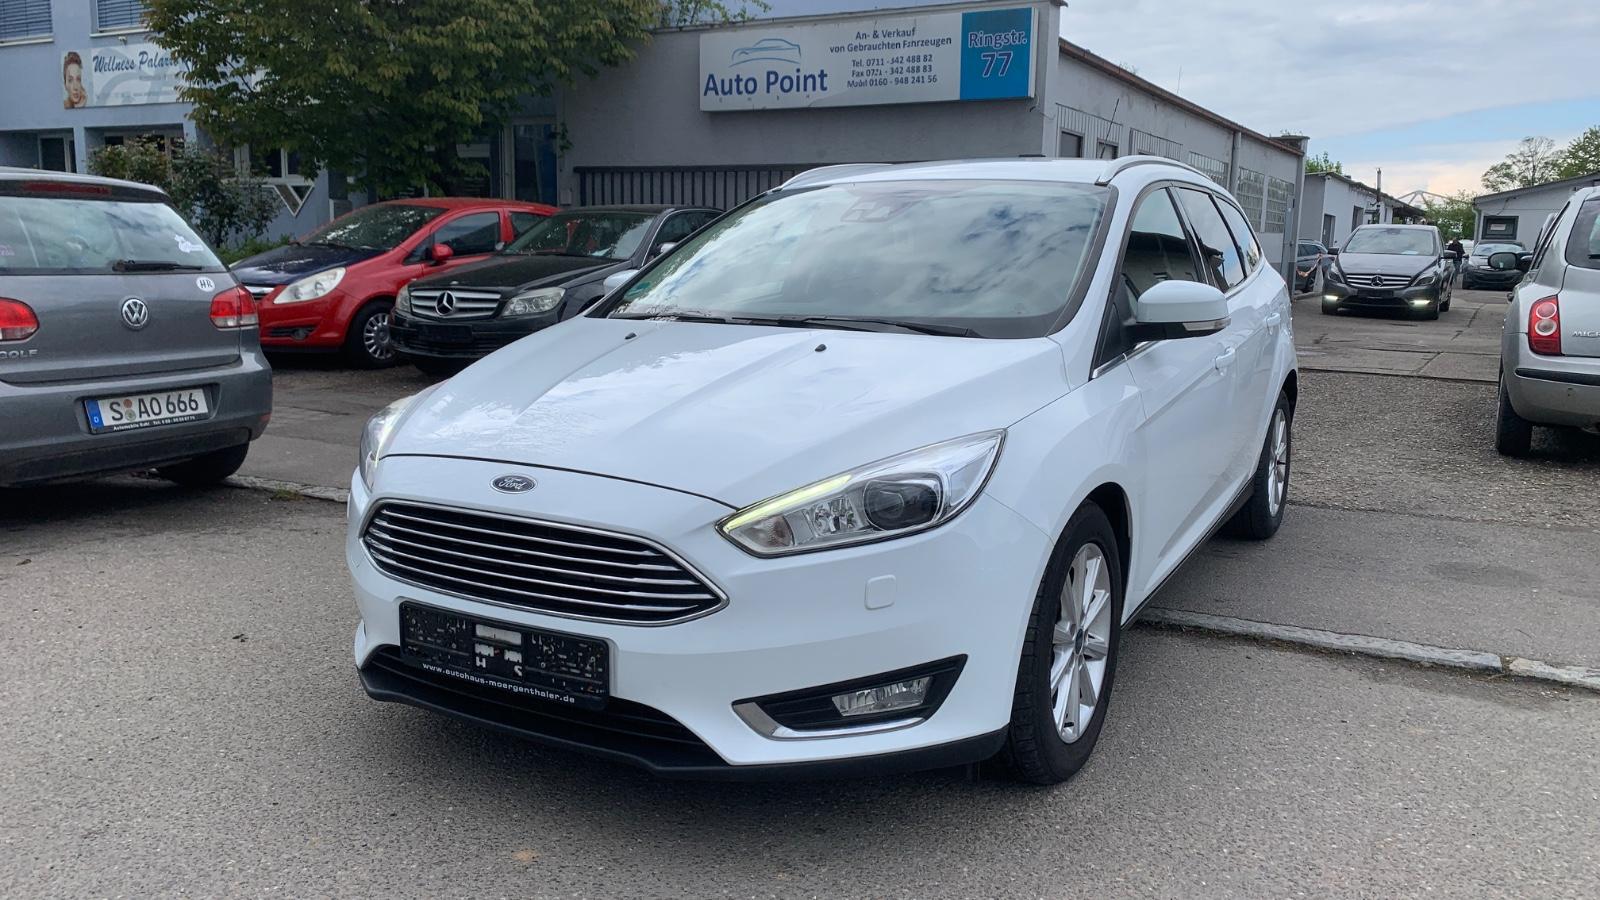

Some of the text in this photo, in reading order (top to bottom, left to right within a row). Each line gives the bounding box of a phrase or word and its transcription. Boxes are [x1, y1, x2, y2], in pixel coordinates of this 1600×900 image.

[855, 27, 916, 40] An- & Verkauf
[968, 29, 1028, 50] Ringstr.
[847, 41, 901, 53] Gebrauchten
[902, 37, 952, 49] Fahrzeugen
[92, 55, 136, 73] Wellness
[851, 59, 864, 68] Tel.
[866, 58, 884, 67] 0711
[890, 57, 904, 65] 342
[906, 55, 920, 64] 488
[922, 54, 933, 62] 82
[981, 51, 1013, 78] 77
[851, 69, 864, 78] Fax
[889, 67, 904, 75] 342
[905, 65, 920, 74] 488
[922, 64, 932, 73] 83
[703, 68, 828, 96] Auto Point
[869, 78, 887, 87] 0160
[894, 76, 909, 86] 948
[911, 75, 925, 84] 241
[927, 74, 937, 83] 56
[200, 279, 213, 289] HR
[109, 392, 199, 421] S AO 666
[498, 477, 528, 490] Ford
[422, 662, 576, 704] www.autohaus-moergenthaler.de
